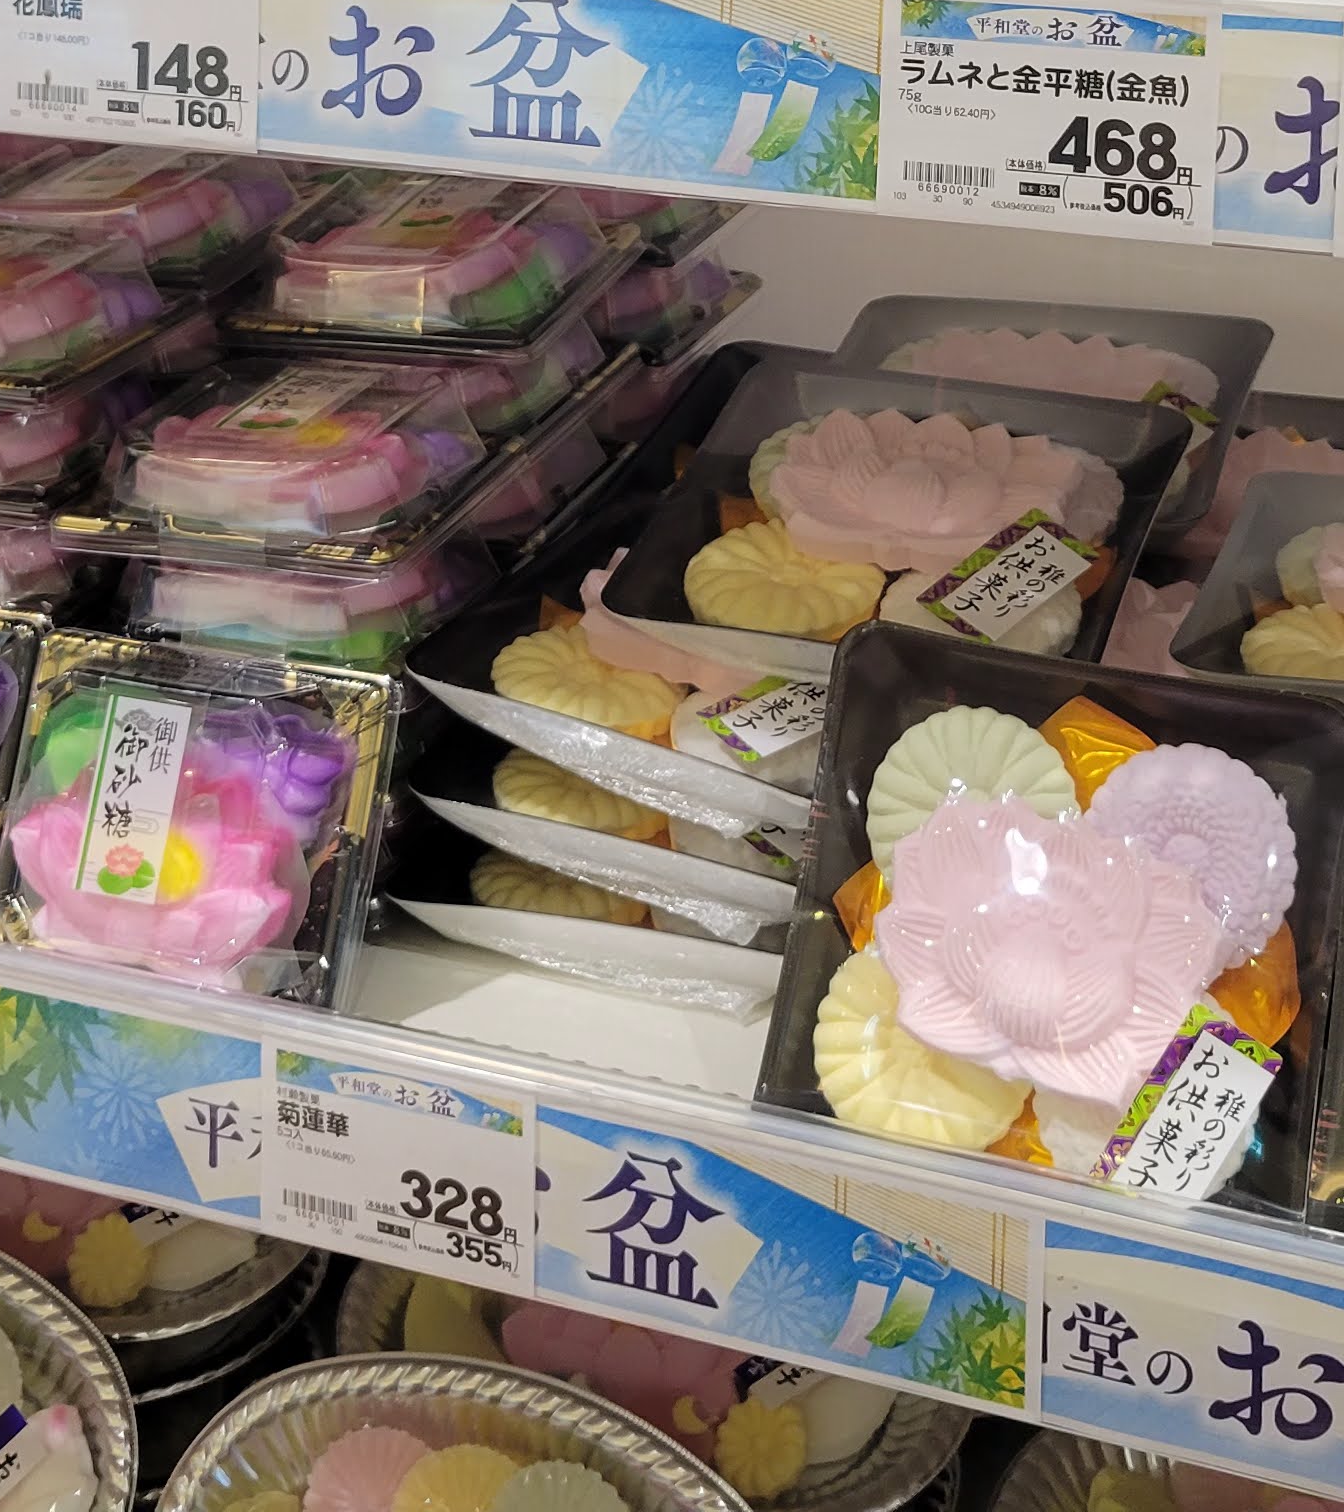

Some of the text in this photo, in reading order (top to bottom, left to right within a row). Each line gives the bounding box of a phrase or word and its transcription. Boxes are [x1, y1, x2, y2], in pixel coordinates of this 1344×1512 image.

[900, 41, 955, 58] 上尾製菓
[975, 14, 1122, 47] 平和堂のお盆
[898, 88, 922, 103] 75g
[900, 57, 1189, 108] ラムネと金平糖(金魚)
[918, 182, 979, 197] 66690012
[954, 533, 1056, 616] お供菓子
[148, 715, 179, 776] 御供
[101, 723, 149, 840] 御砂糖
[337, 1076, 456, 1118] 平和堂のお盆
[1125, 1043, 1230, 1190] お供菓子
[277, 1099, 350, 1138] 菊蓮華
